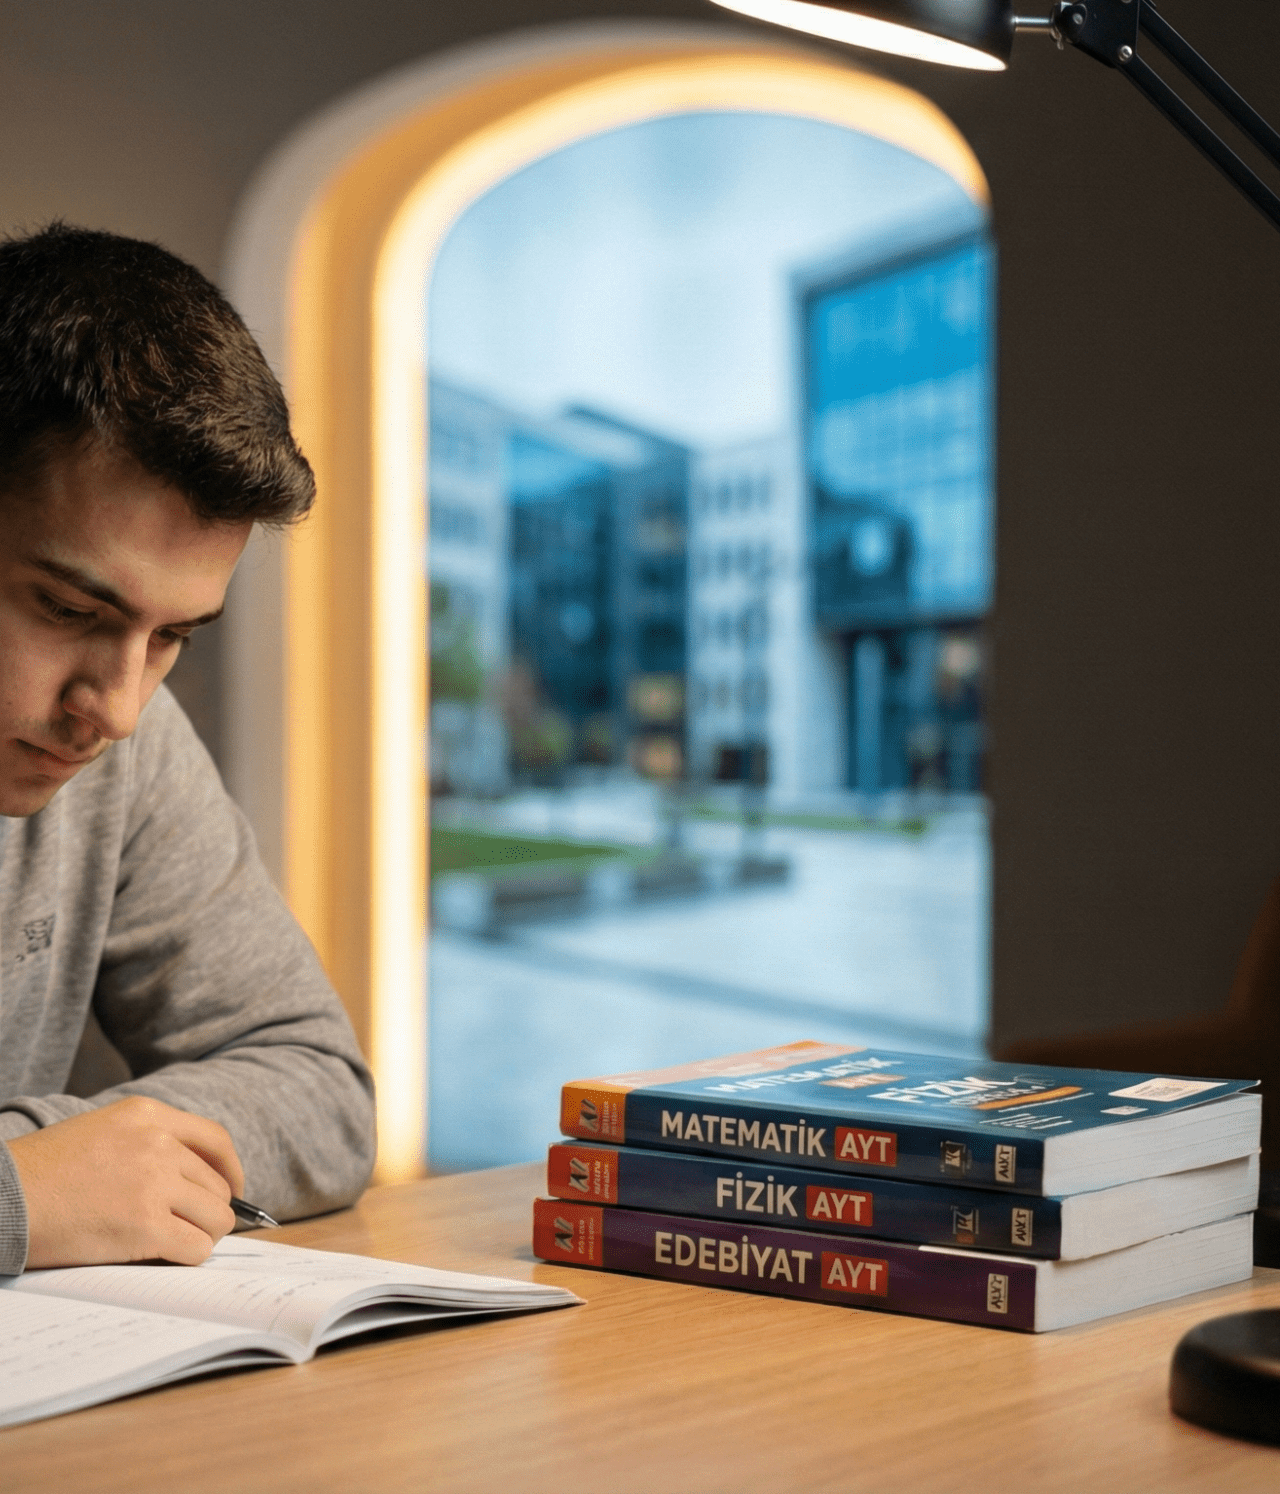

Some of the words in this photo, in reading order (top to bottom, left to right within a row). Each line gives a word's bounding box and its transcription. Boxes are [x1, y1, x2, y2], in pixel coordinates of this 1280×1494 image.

[661, 1110, 827, 1157] MATEMATİK
[840, 1132, 892, 1163] AYT
[716, 1171, 798, 1217] FİZİK
[812, 1191, 867, 1222] AYT
[655, 1231, 813, 1284] EDEBİYAT
[827, 1258, 883, 1291] AYT
